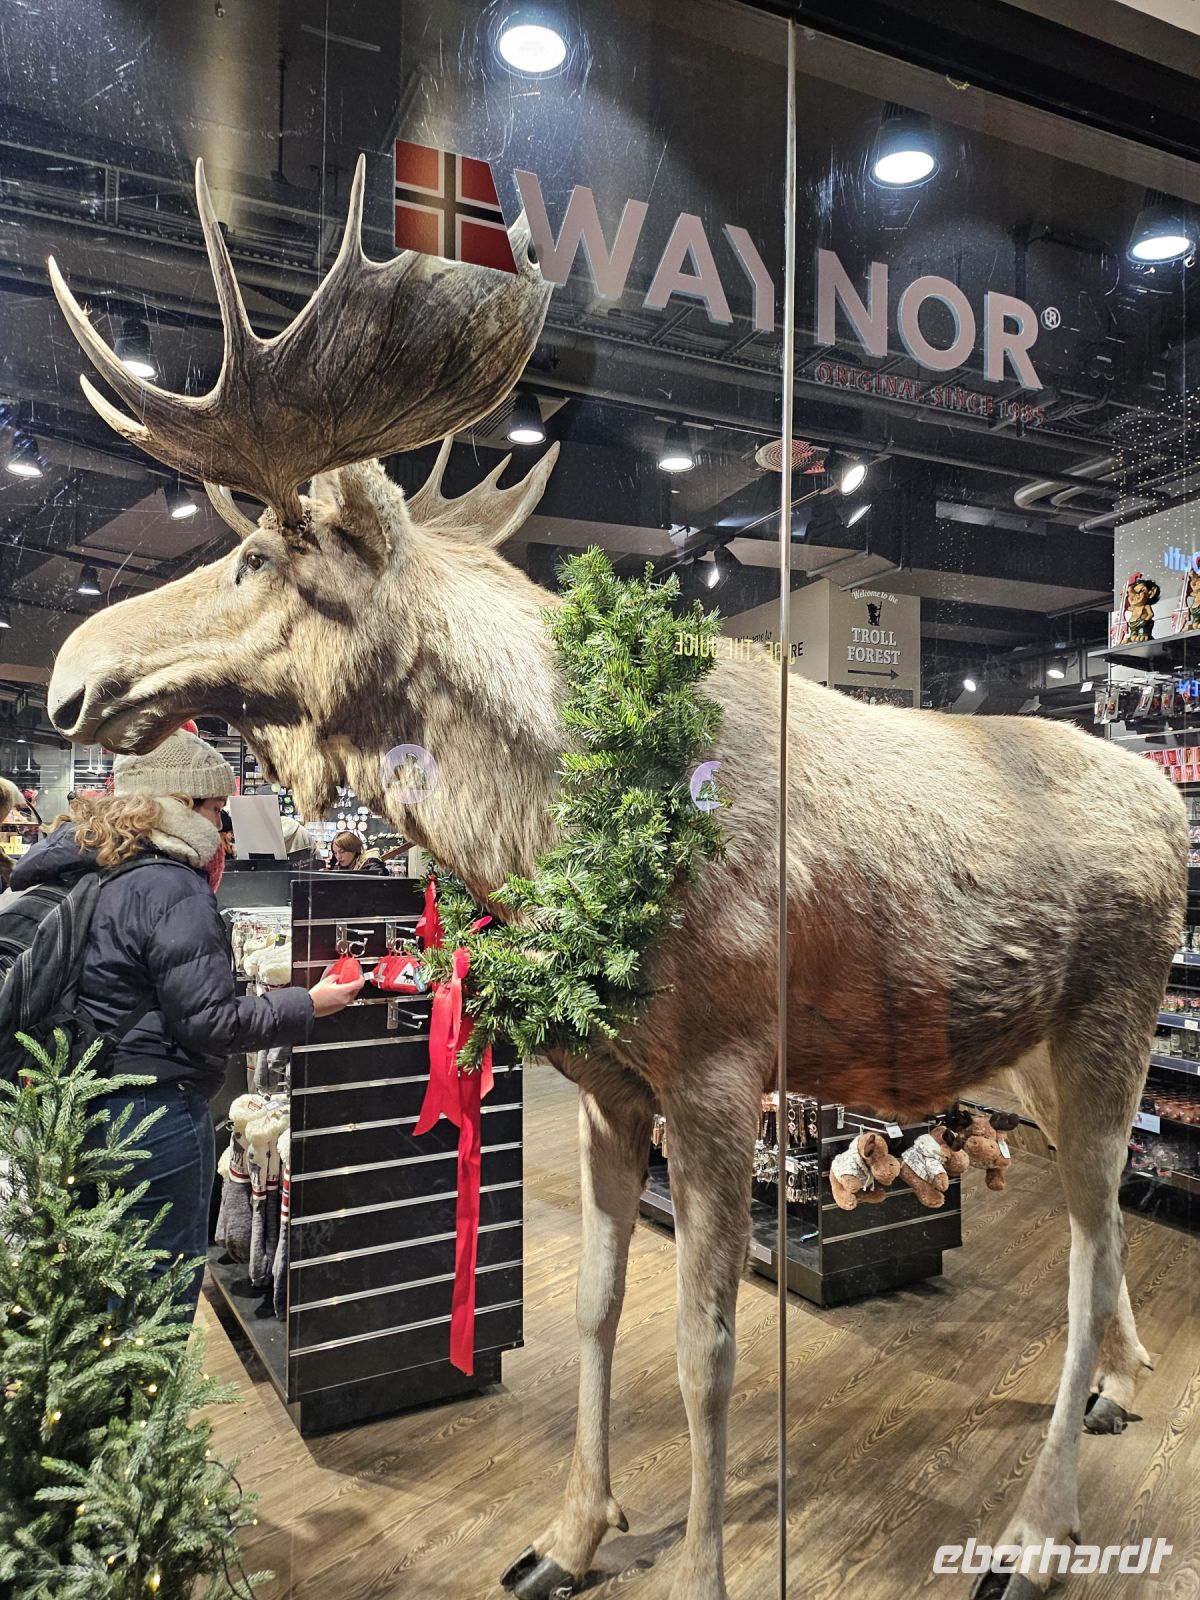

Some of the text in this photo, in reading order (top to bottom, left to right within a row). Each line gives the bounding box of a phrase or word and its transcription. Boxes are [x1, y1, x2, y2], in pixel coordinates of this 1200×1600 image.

[815, 363, 1047, 426] ORIGINAL SINCE 1985
[851, 589, 899, 604] Welcome to the
[851, 627, 897, 646] TROLL
[848, 646, 901, 665] FOREST
